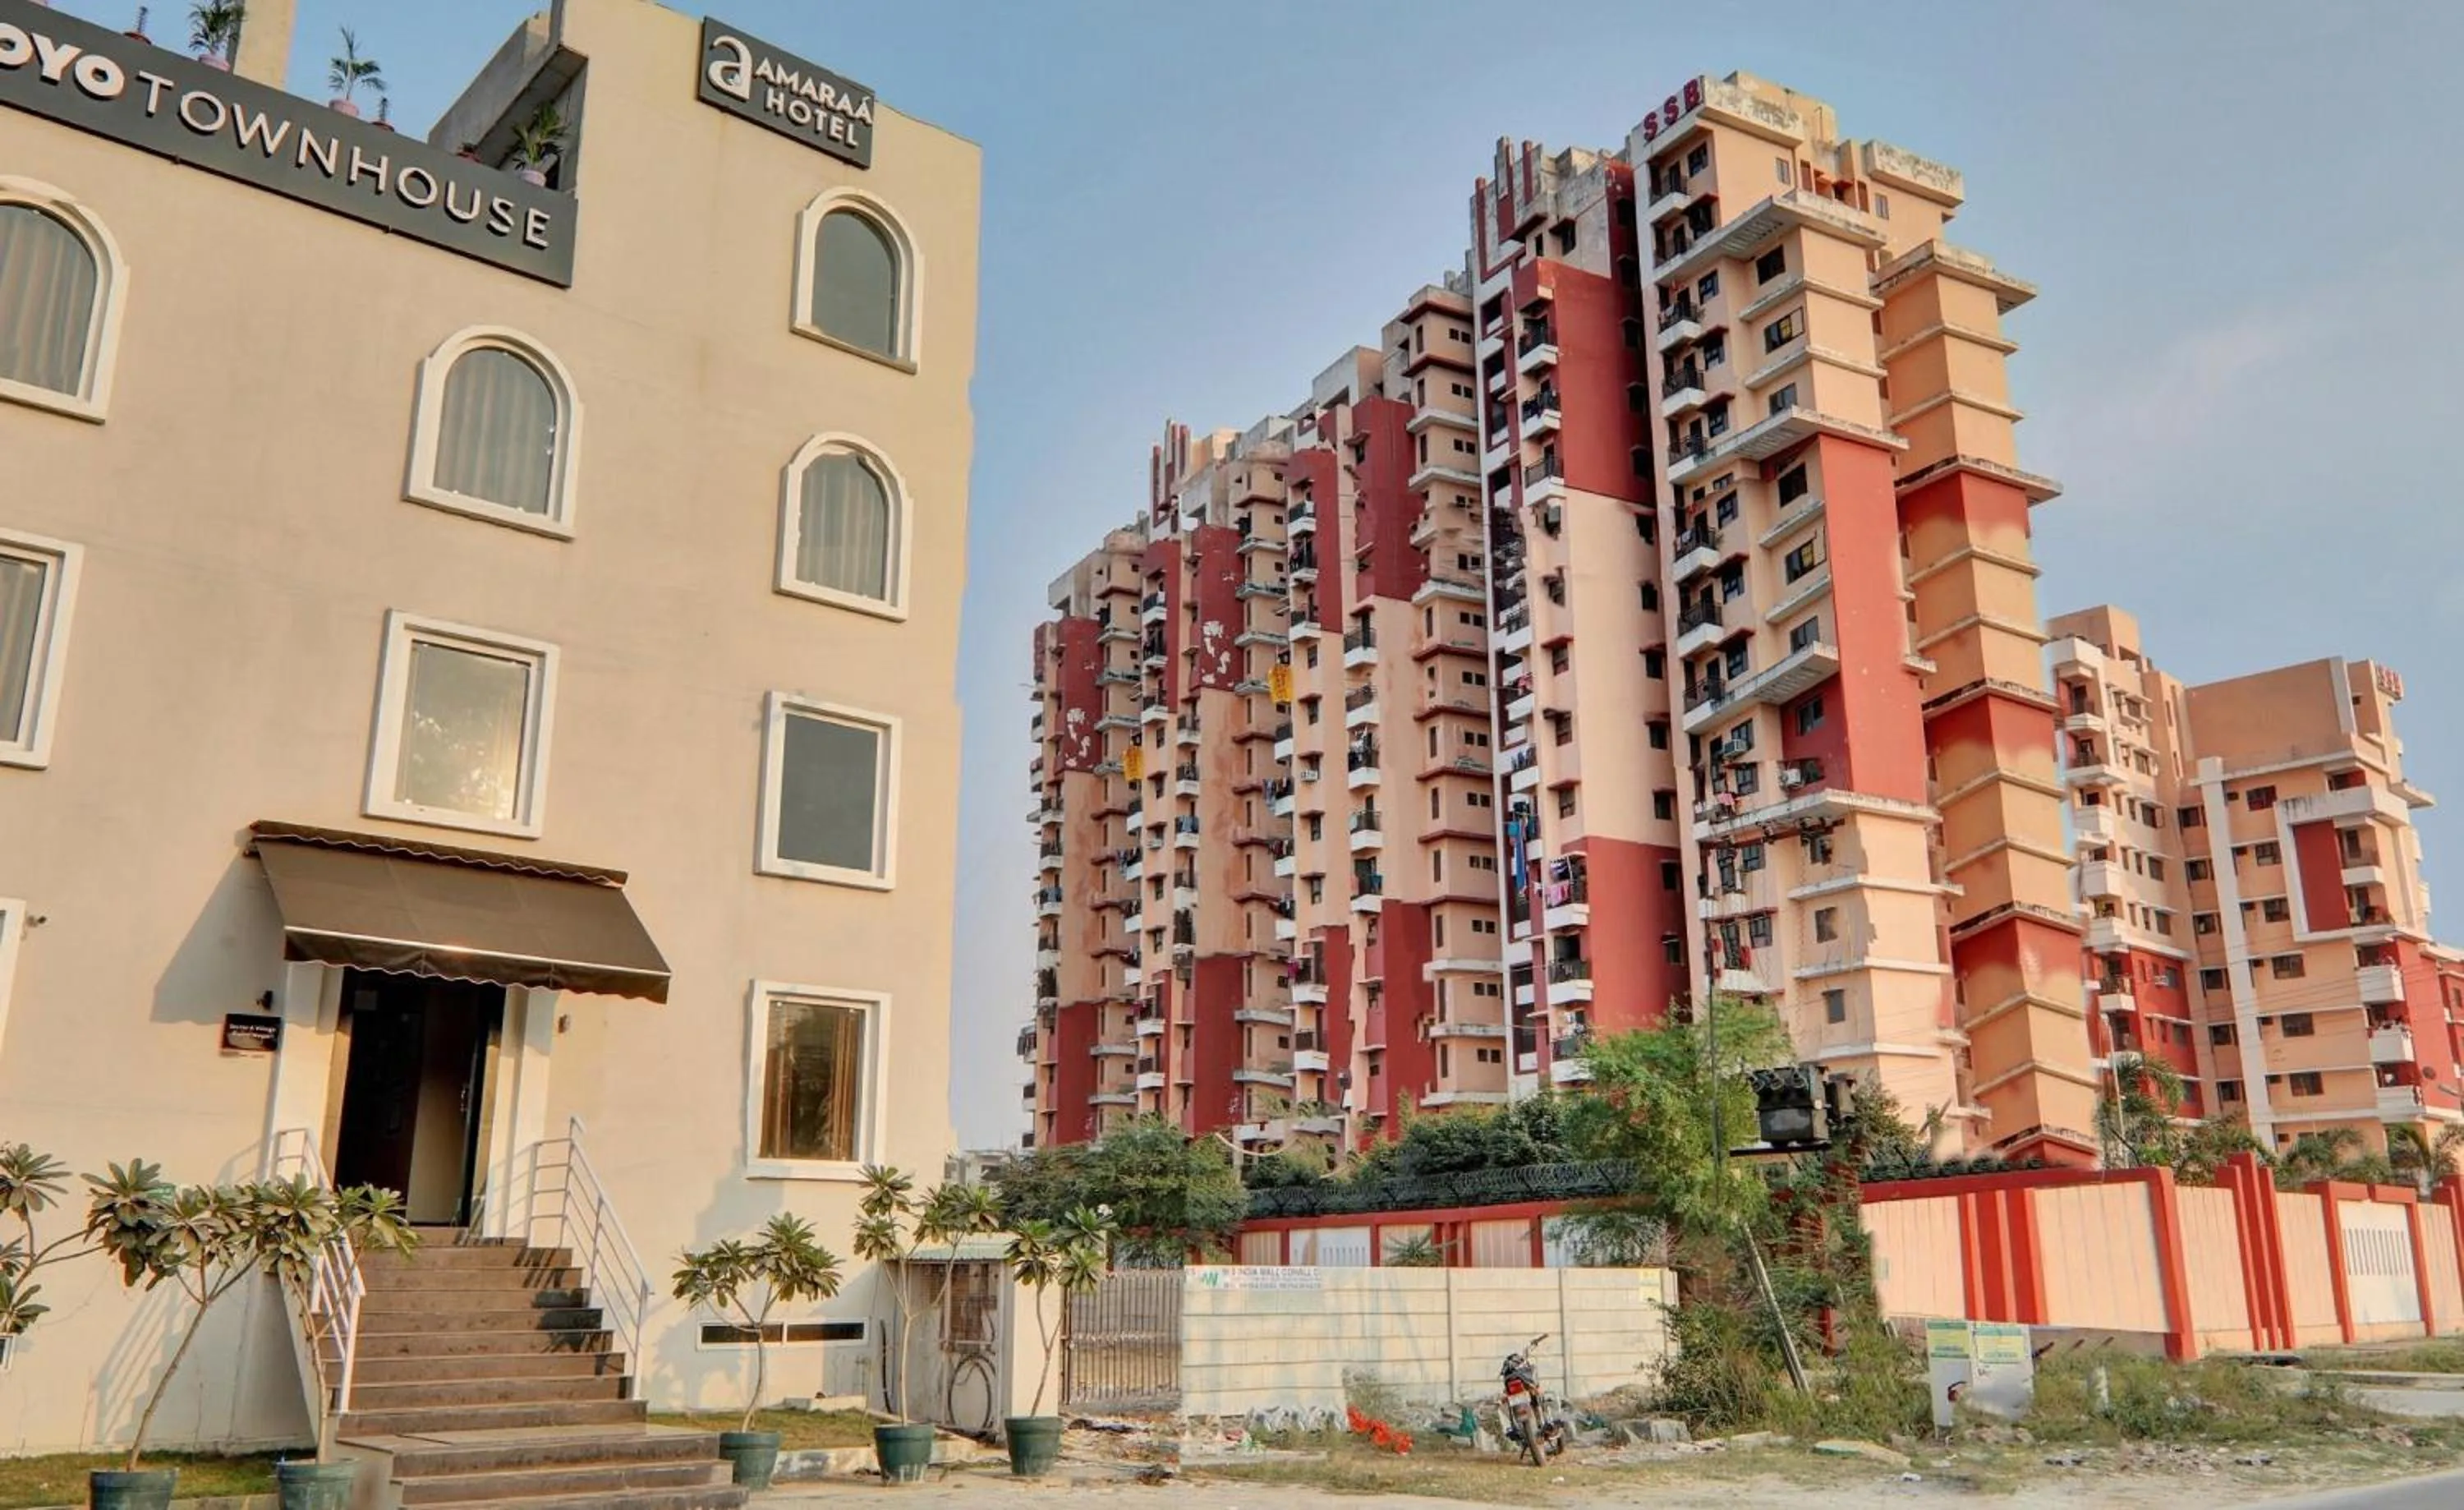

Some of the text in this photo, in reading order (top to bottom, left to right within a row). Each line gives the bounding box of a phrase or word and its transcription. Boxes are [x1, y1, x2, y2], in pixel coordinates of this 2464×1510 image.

[0, 22, 551, 248] OYO TOWNHOUSE
[765, 87, 858, 147] HOTEL
